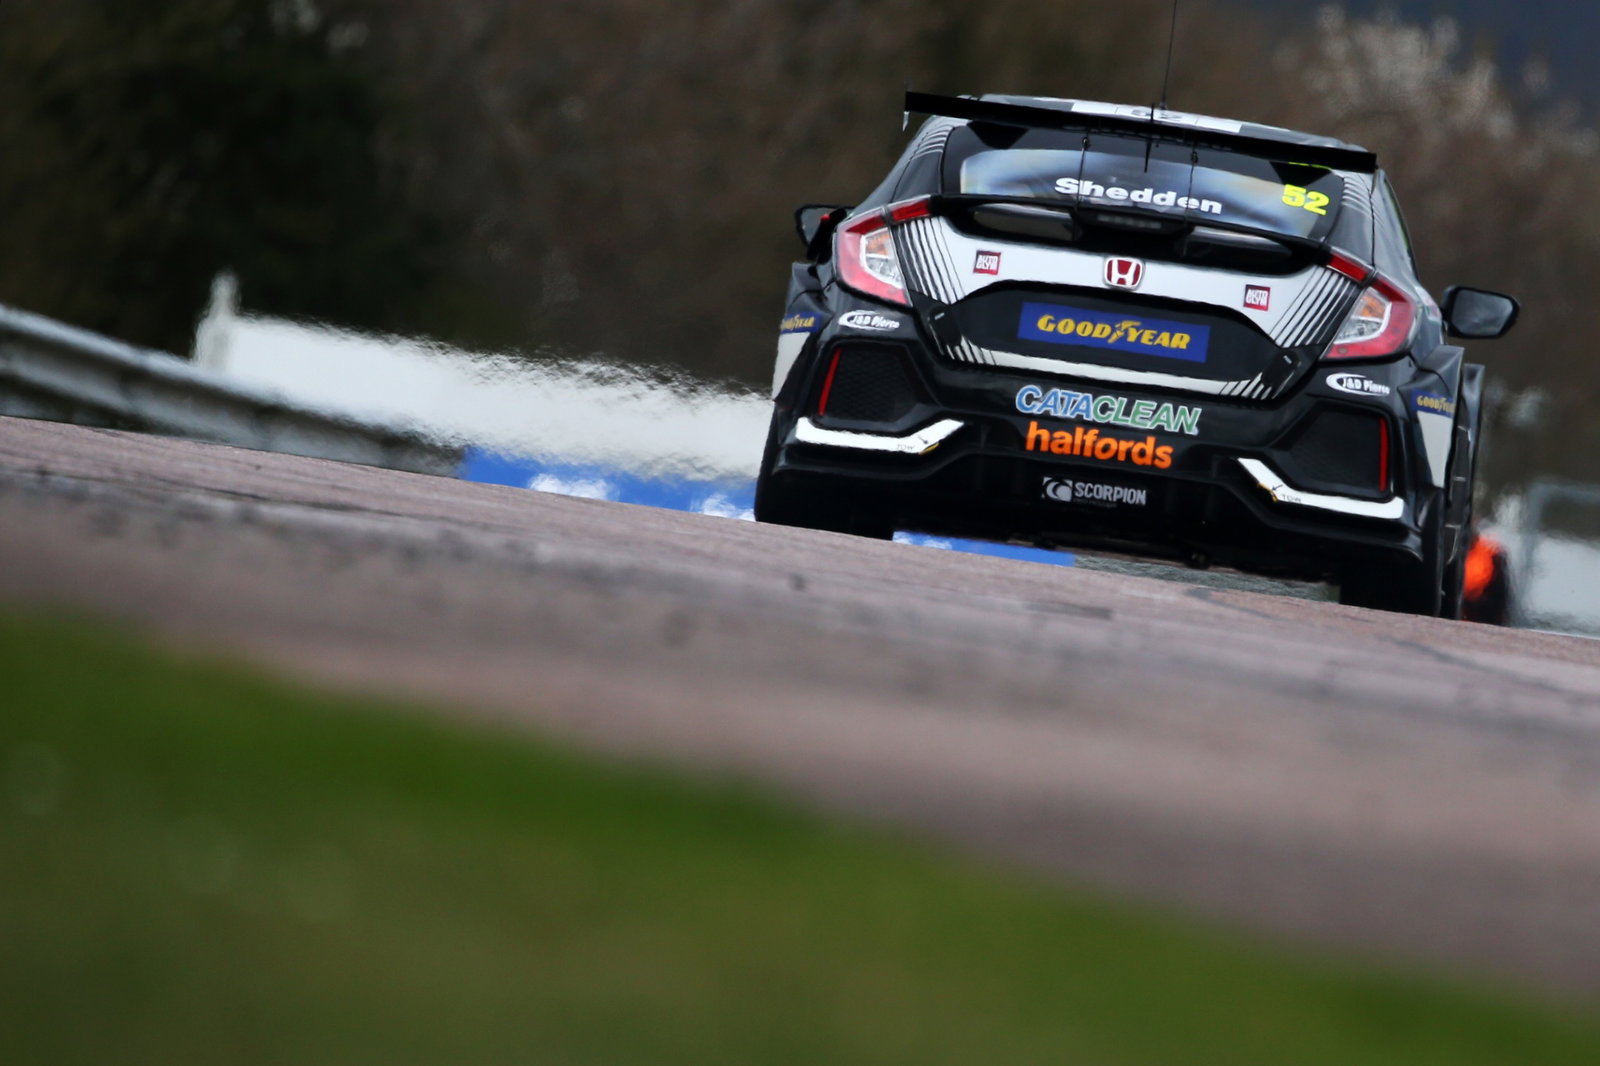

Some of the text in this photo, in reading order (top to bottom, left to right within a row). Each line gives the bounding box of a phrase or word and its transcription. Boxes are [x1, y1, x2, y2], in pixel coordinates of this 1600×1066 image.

[1055, 177, 1222, 215] Shedden
[1281, 184, 1330, 216] 52
[852, 315, 871, 325] J&D
[1036, 314, 1191, 350] GOODYEAR
[1342, 377, 1362, 390] J&D
[1015, 384, 1202, 435] CATACLEAN
[1025, 420, 1174, 469] halfords
[1075, 481, 1147, 505] SCORPION
